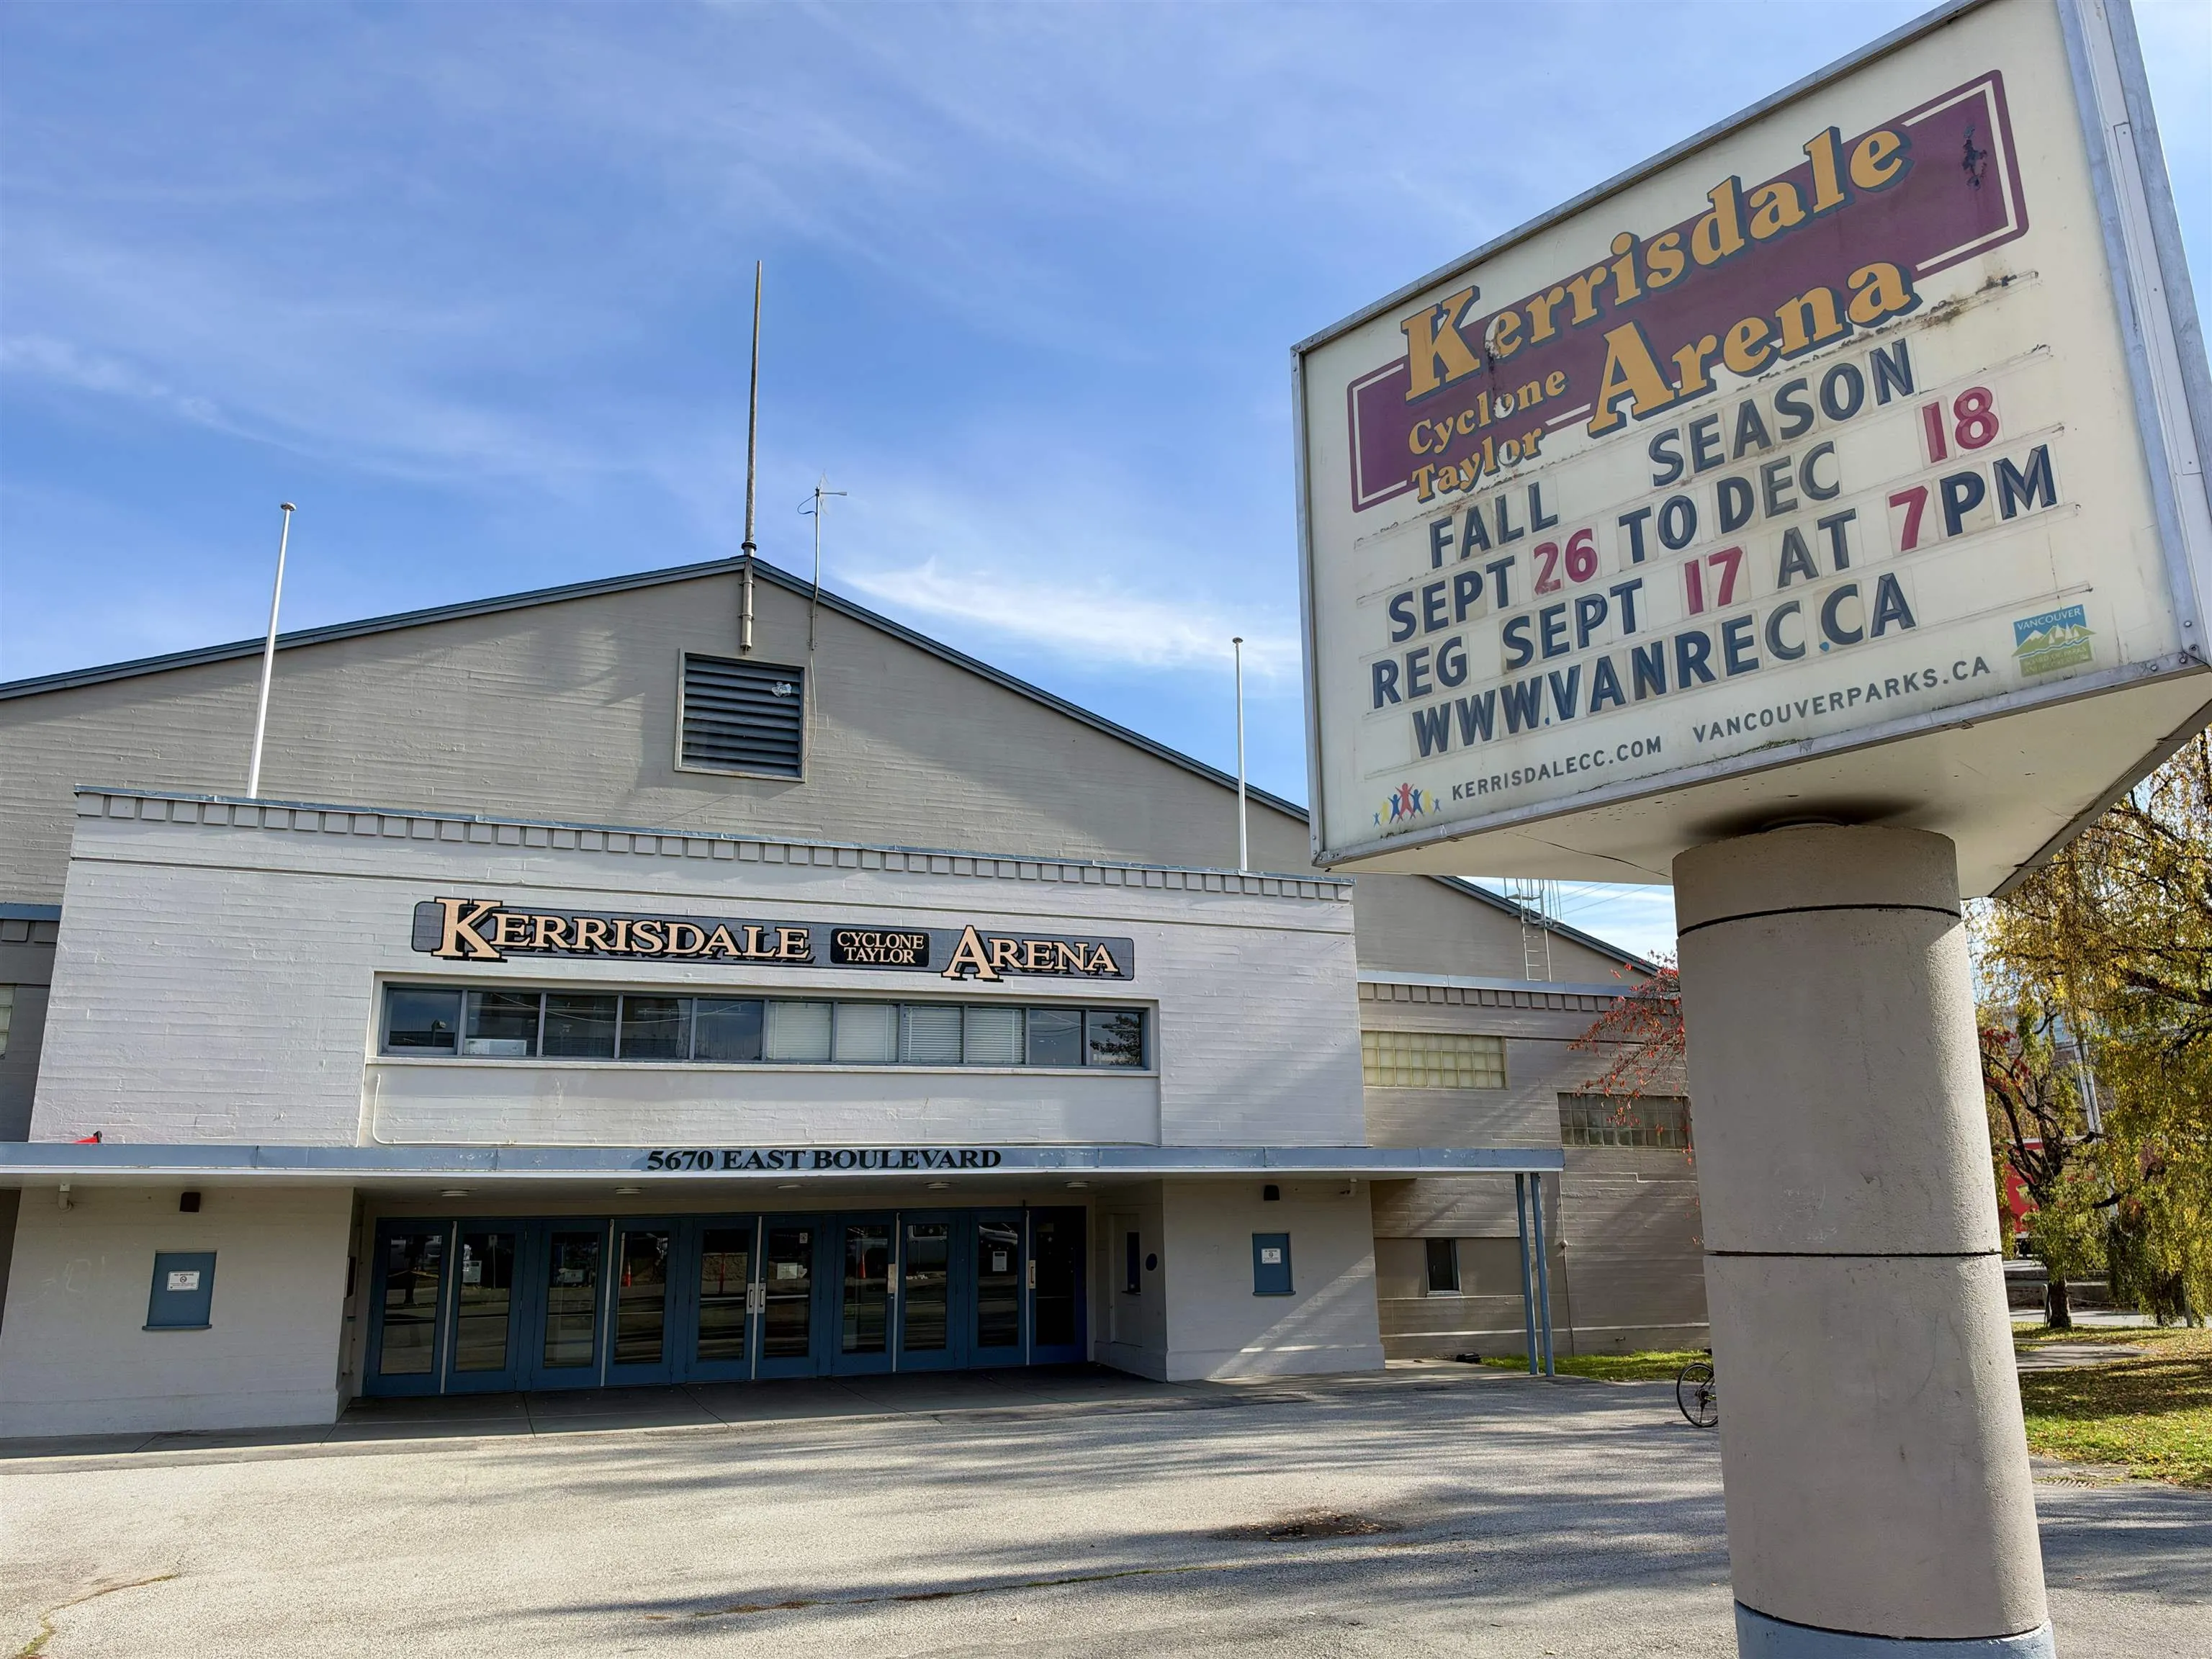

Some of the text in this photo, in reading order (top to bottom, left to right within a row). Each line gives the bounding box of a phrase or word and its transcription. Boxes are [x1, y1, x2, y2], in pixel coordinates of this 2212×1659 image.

[1401, 126, 1914, 404] Kerrisdale
[1587, 261, 1923, 439] Arena
[1408, 368, 1571, 455] Cyclone
[1429, 338, 1915, 568] FALL SEASON
[1411, 423, 1546, 503] Taylor
[1389, 386, 2000, 642] SEPT 26 TO DEC 18
[1372, 636, 1467, 709] REG
[1502, 577, 1642, 670] SEPT
[1684, 546, 1743, 615] 17
[1777, 508, 1857, 589] AT
[2017, 608, 2082, 630] VANCOUVER
[1413, 572, 1916, 757] WWW.VANREC.CA
[1692, 656, 1990, 743] VANCOUVERPARKS.CA
[1452, 736, 1662, 801] KERRISDALECC.COM
[431, 897, 815, 963] KERRISDALE
[837, 931, 925, 950] CYCLONE
[843, 946, 916, 964] TAYLOR
[941, 925, 1125, 982] ARENA
[647, 1148, 1002, 1171] 5670 EAST BOULEVARD
